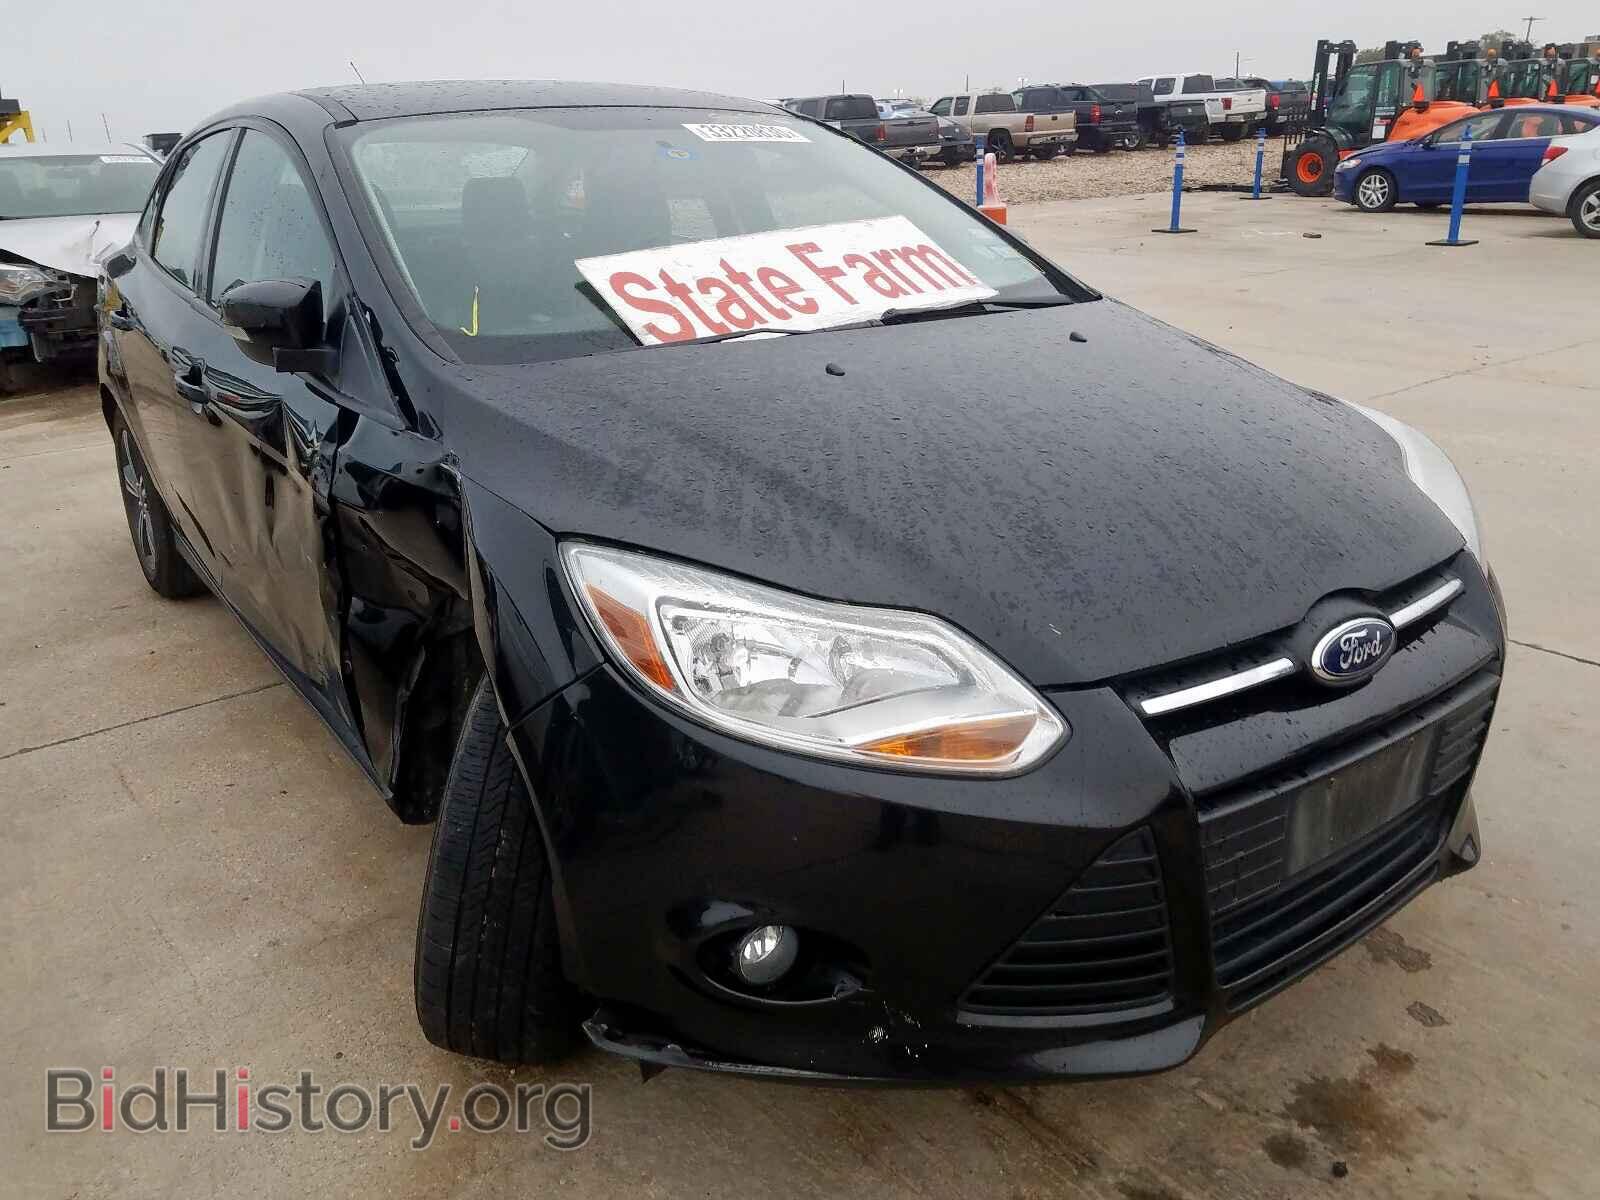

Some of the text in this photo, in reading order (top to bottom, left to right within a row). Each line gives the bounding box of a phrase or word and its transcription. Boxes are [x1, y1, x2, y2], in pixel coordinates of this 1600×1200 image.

[609, 242, 976, 342] State Farm
[1340, 628, 1383, 669] Ford
